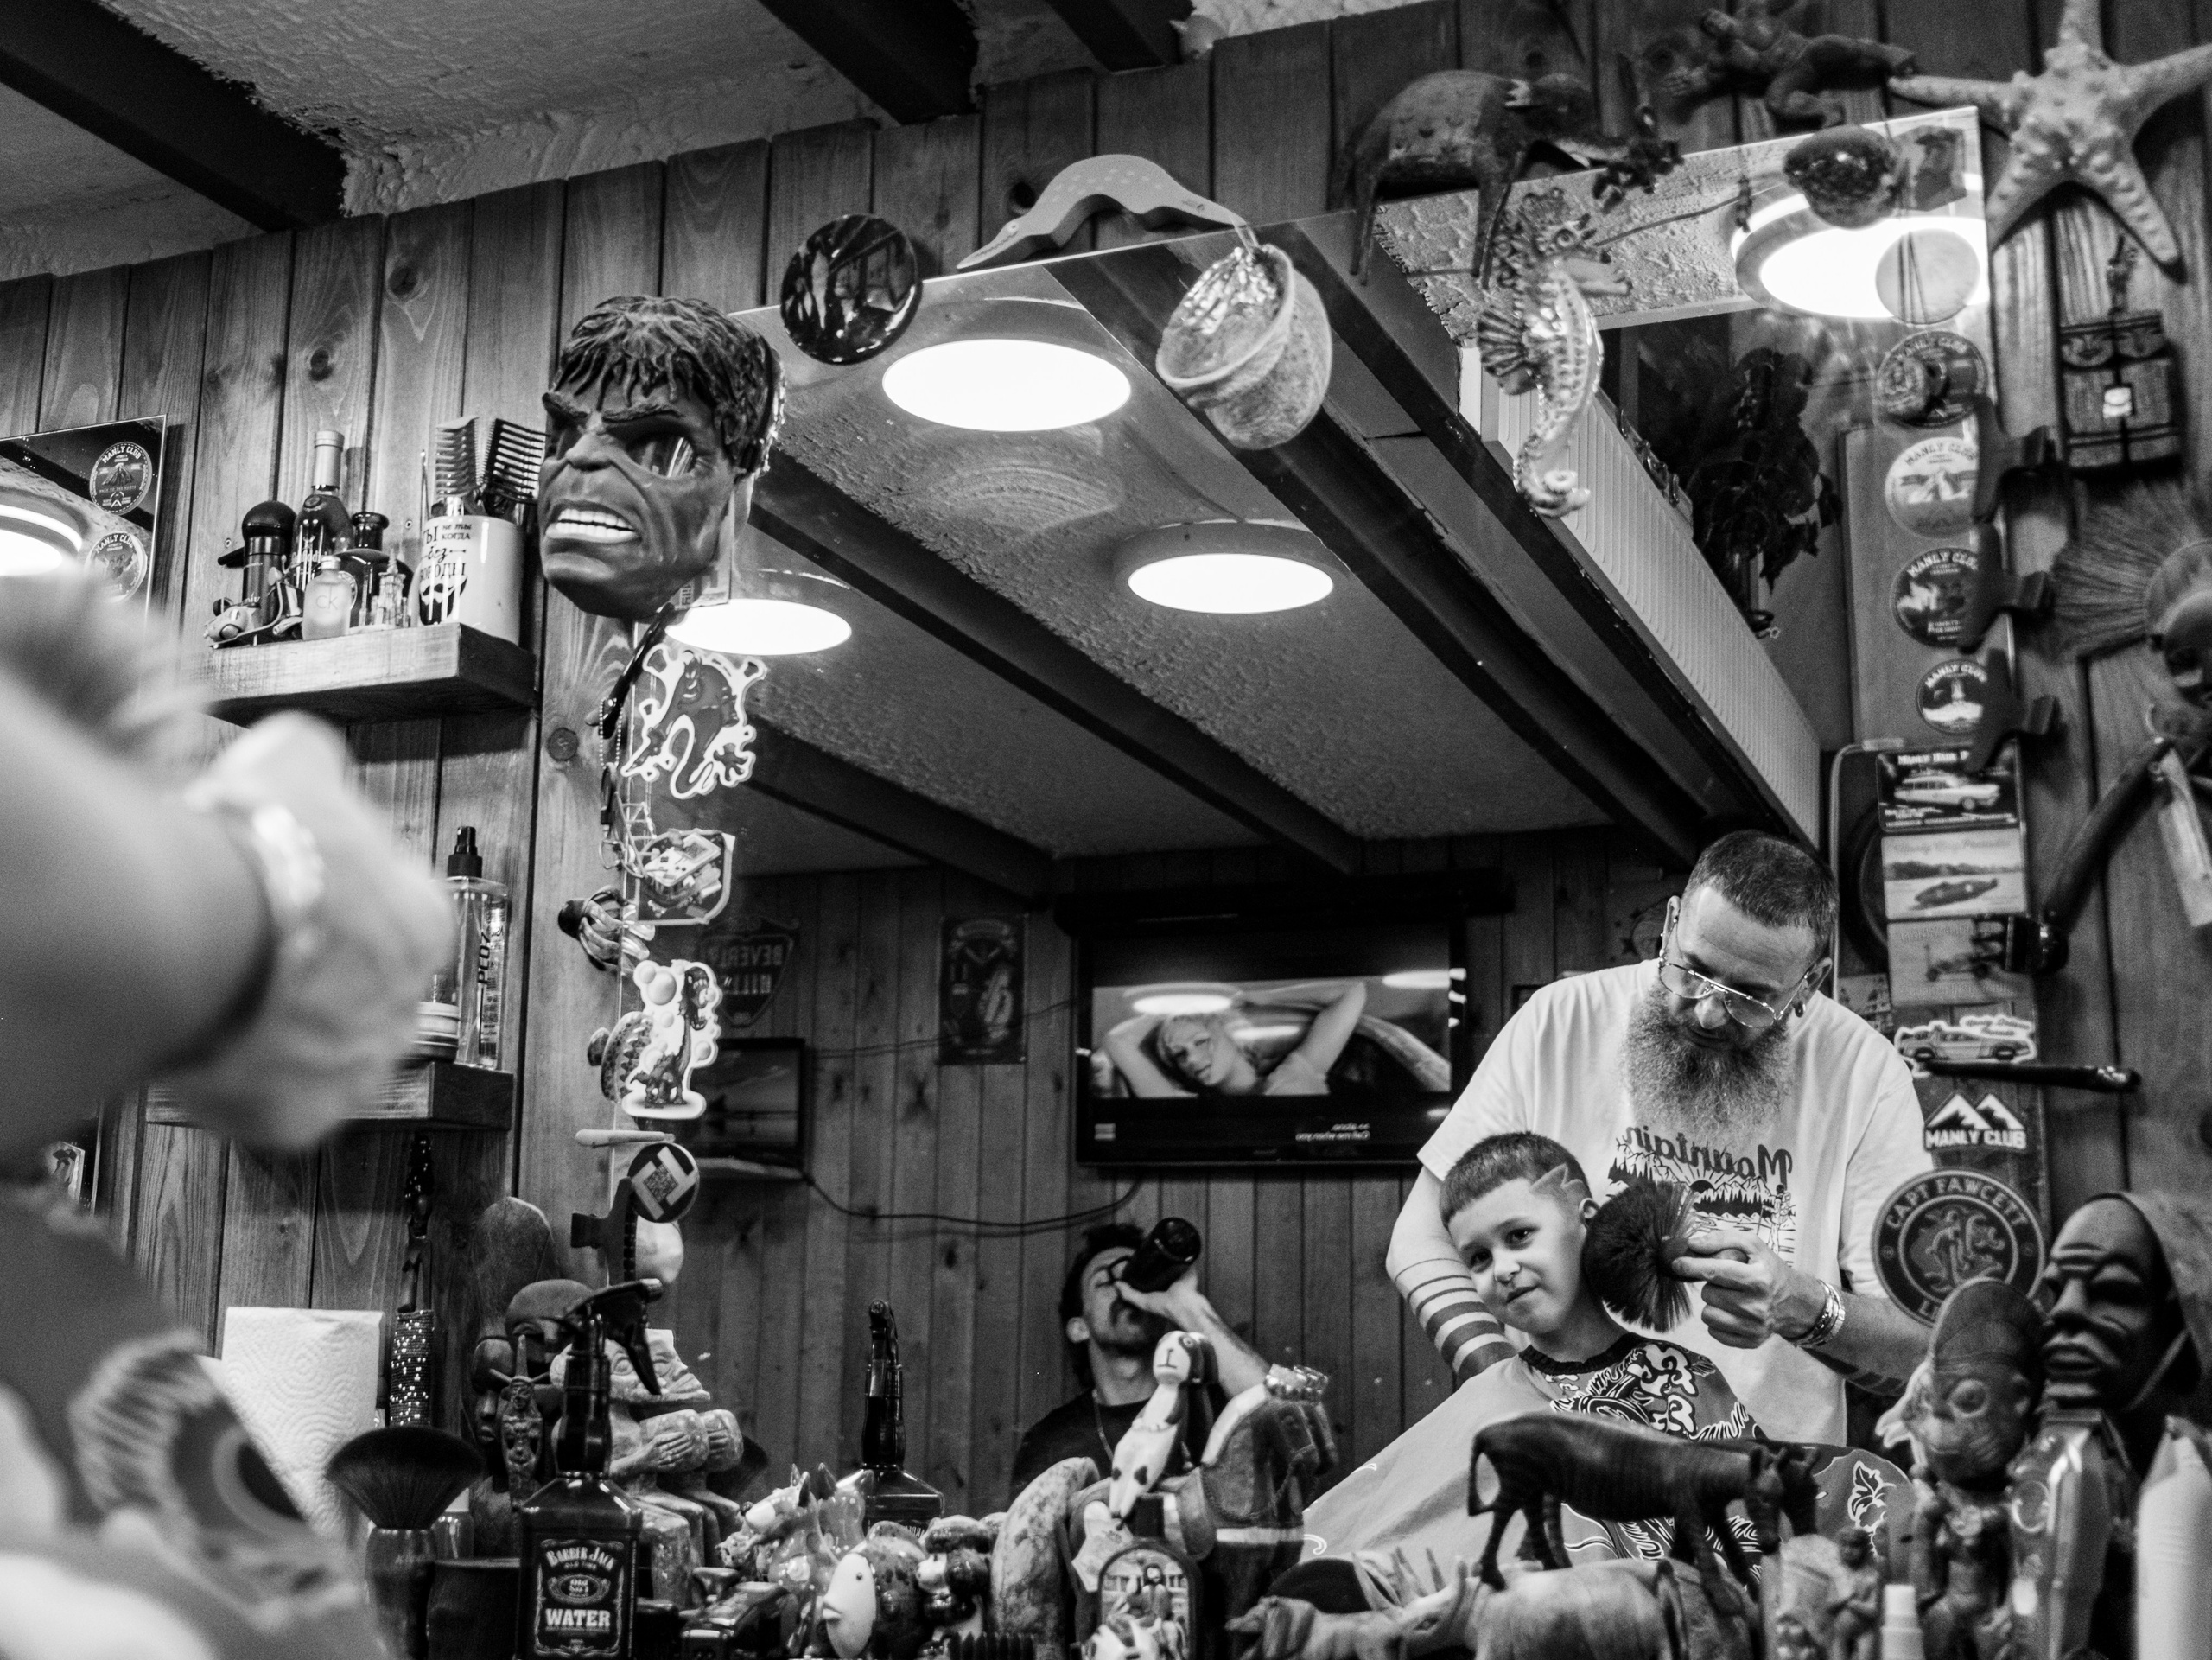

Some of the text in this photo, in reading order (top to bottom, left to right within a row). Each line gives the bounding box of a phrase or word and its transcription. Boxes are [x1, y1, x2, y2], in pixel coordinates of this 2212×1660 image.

[102, 446, 125, 464] MANLY
[125, 446, 142, 460] CLUB
[1904, 442, 1945, 467] MANLY
[94, 534, 119, 554] MANLY
[1906, 551, 1950, 578] MANLY
[1924, 664, 1987, 689] MANLY CLUB
[1924, 1129, 2027, 1150] MANLY CLUB
[1886, 1176, 2029, 1229] CAPT FAWCETT
[544, 1608, 611, 1627] WATER
